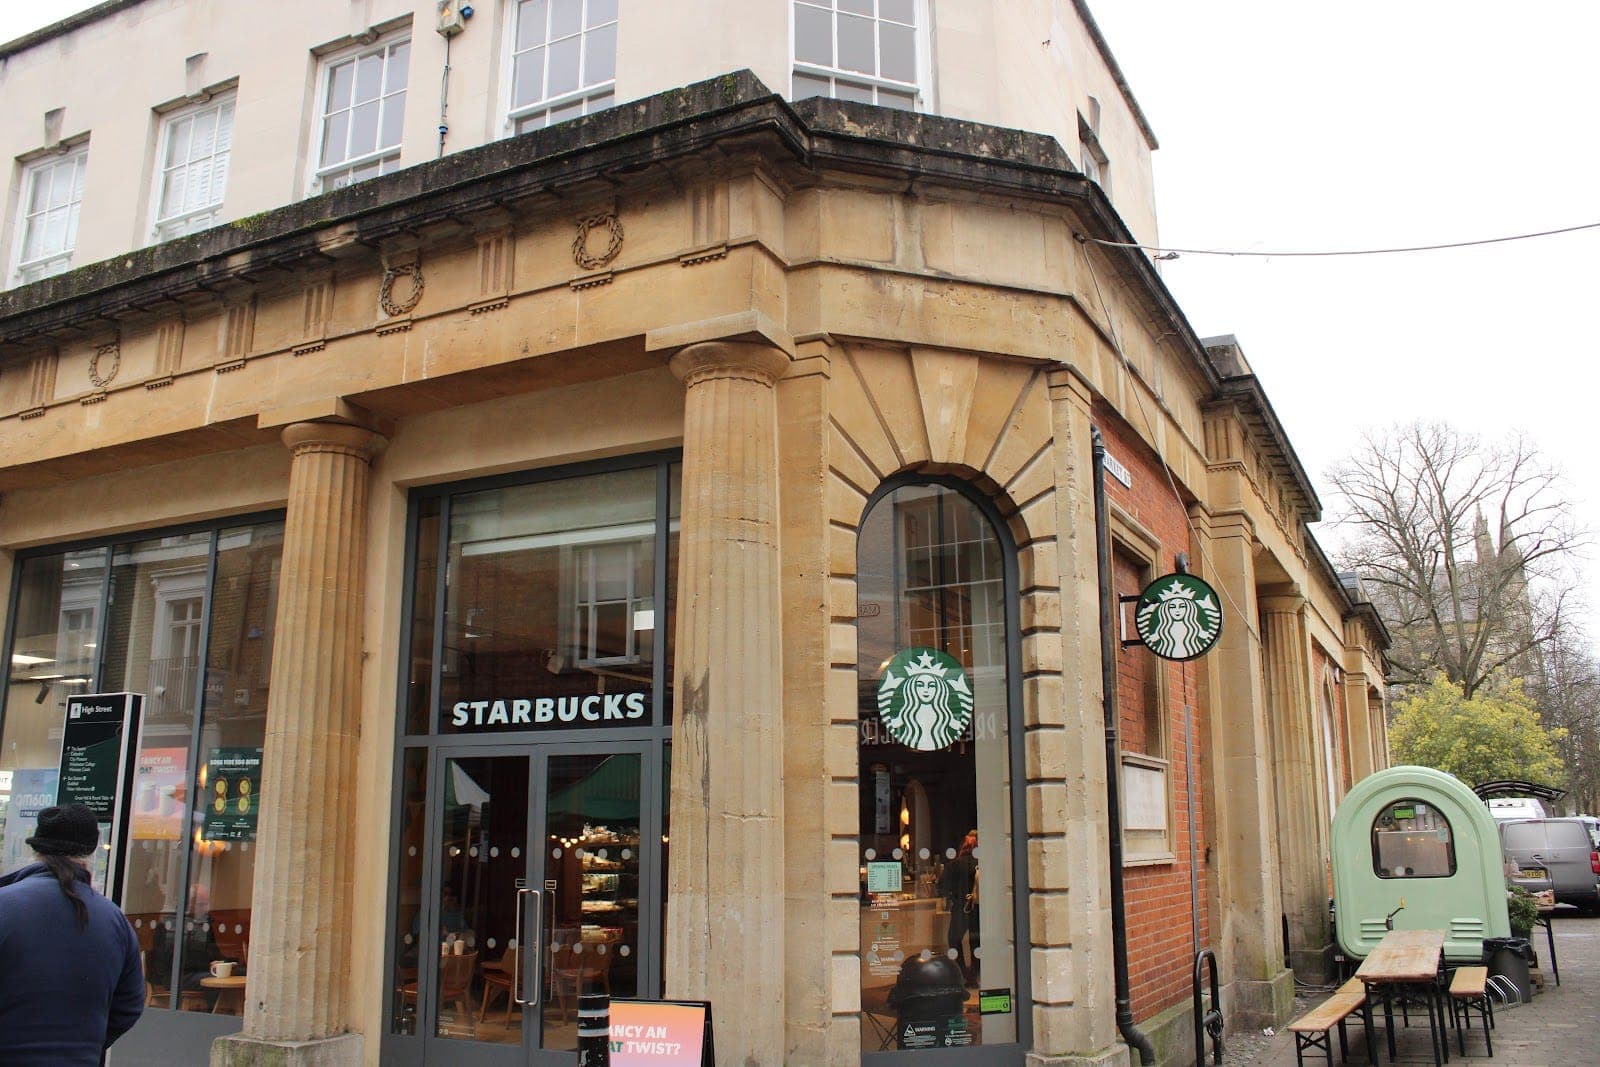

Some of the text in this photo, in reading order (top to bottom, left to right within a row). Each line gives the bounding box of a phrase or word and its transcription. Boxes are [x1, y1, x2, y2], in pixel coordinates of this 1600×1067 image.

[82, 705, 112, 715] High Street
[452, 693, 645, 727] STARBUCKS
[608, 1024, 667, 1039] ANCY AN
[626, 1040, 681, 1056] TWIST?
